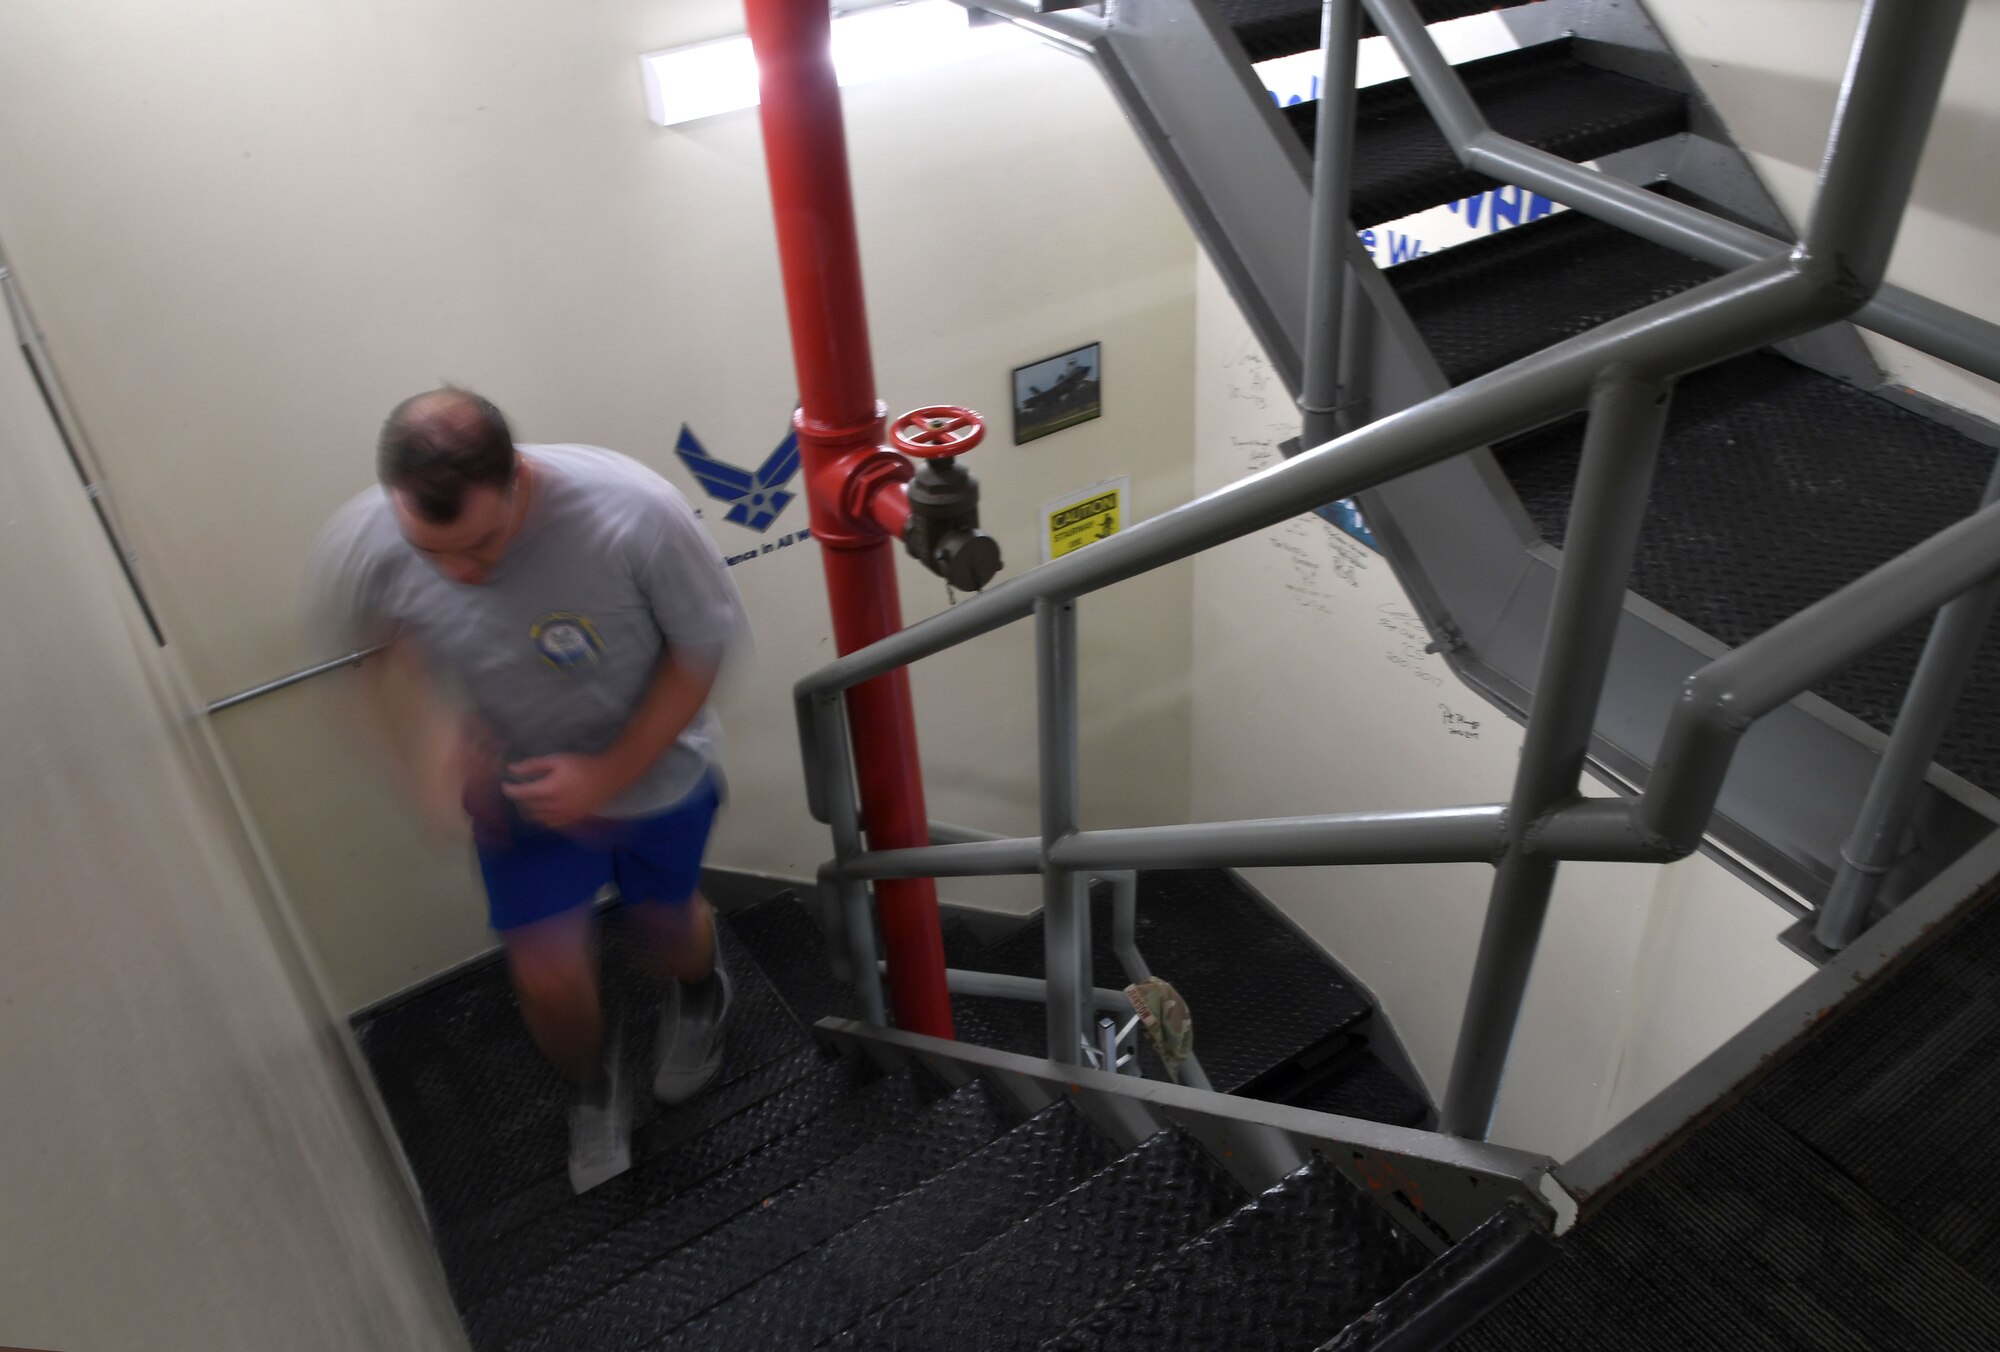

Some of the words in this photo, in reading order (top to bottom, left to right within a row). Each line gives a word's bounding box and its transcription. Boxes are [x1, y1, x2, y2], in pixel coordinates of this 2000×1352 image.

[1053, 494, 1116, 530] CAUTION
[761, 543, 774, 555] in
[777, 534, 794, 549] All
